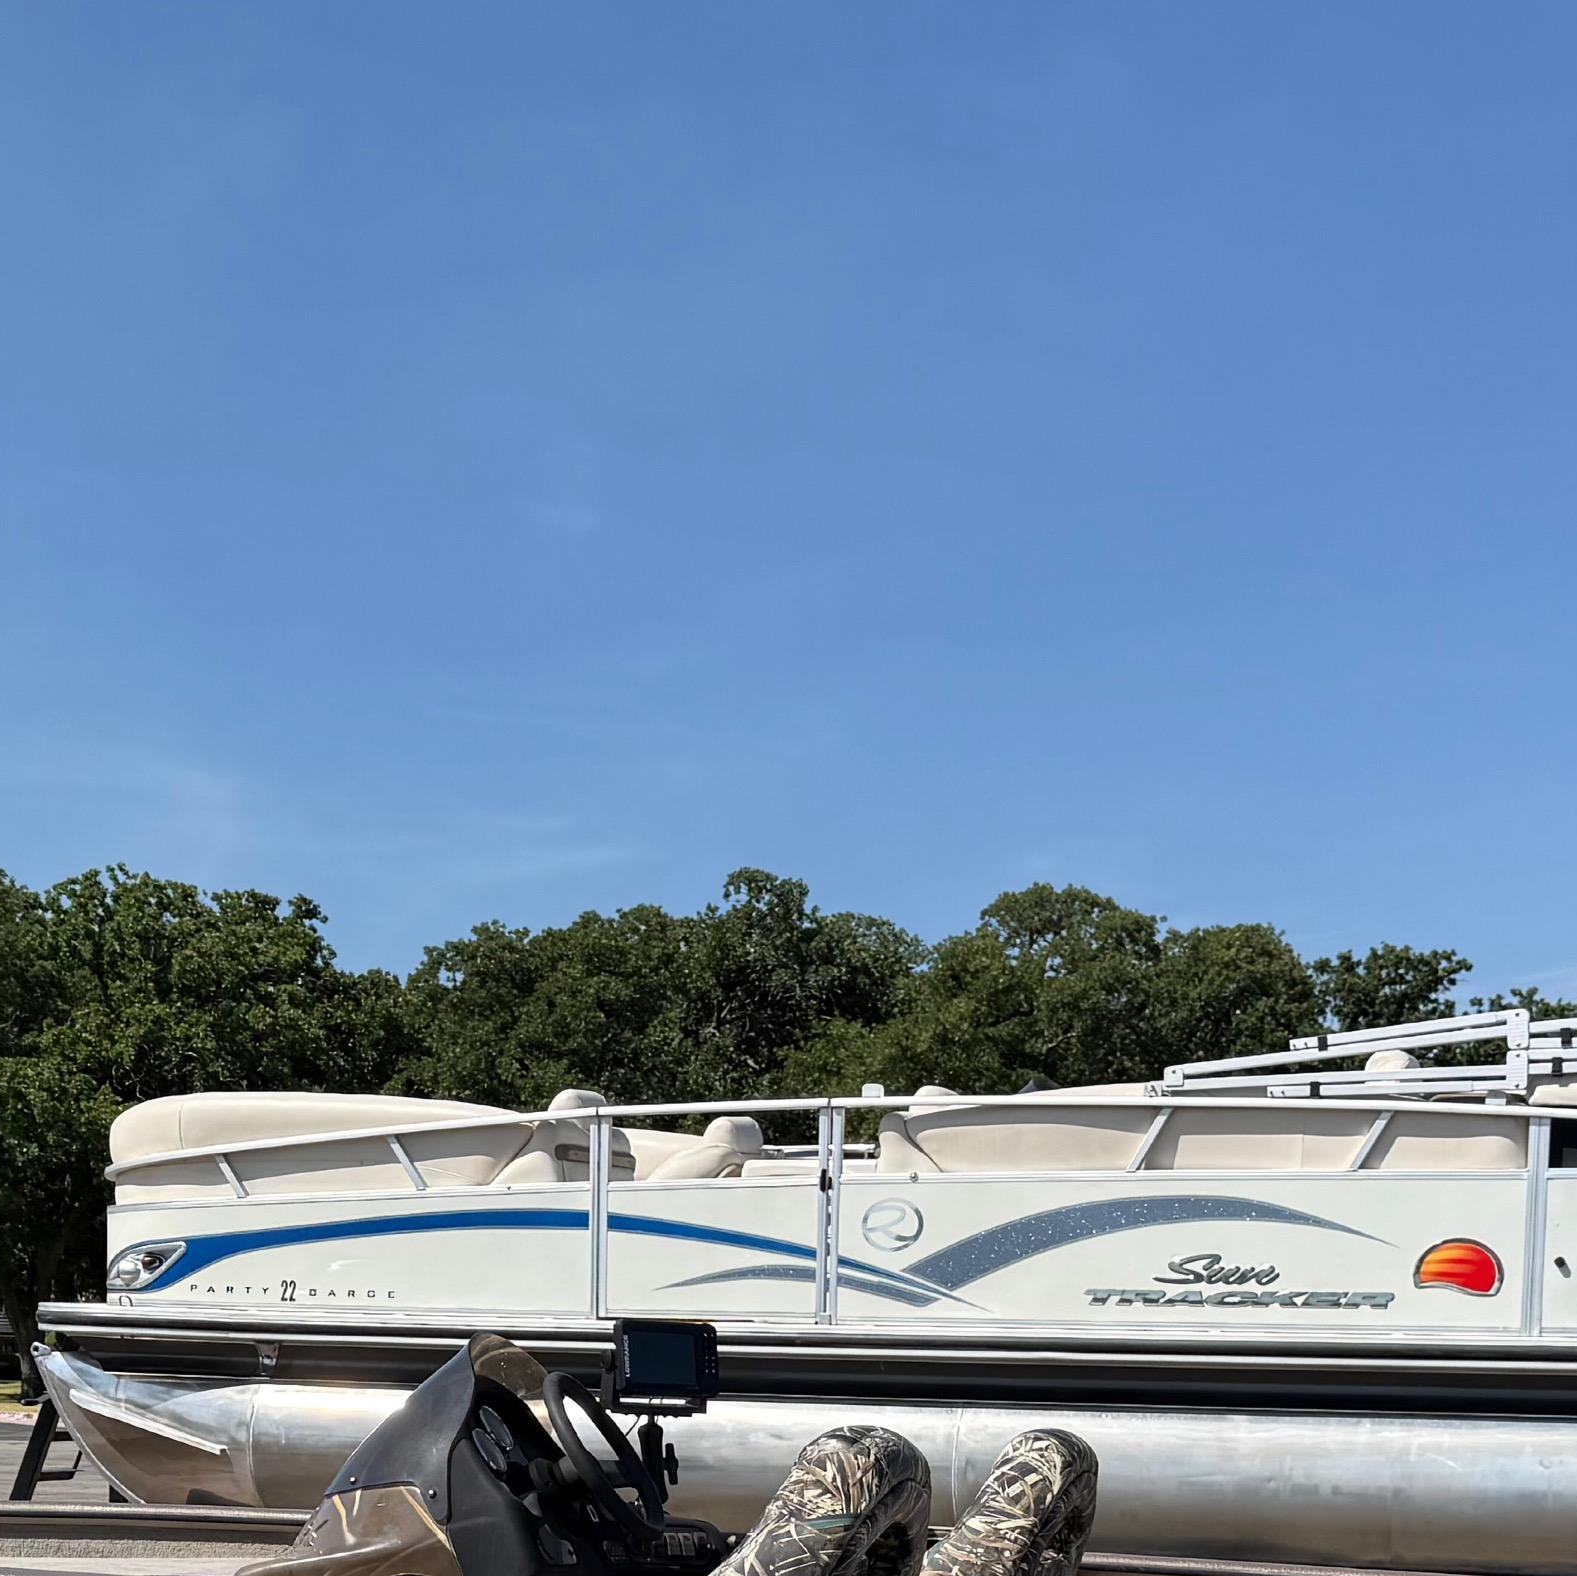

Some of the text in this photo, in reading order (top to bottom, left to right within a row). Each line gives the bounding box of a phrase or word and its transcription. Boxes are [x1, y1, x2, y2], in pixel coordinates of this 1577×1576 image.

[1152, 1253, 1280, 1286] Sun
[190, 1284, 270, 1296] PARTY
[280, 1279, 297, 1302] 22
[1084, 1288, 1396, 1310] TRACKER
